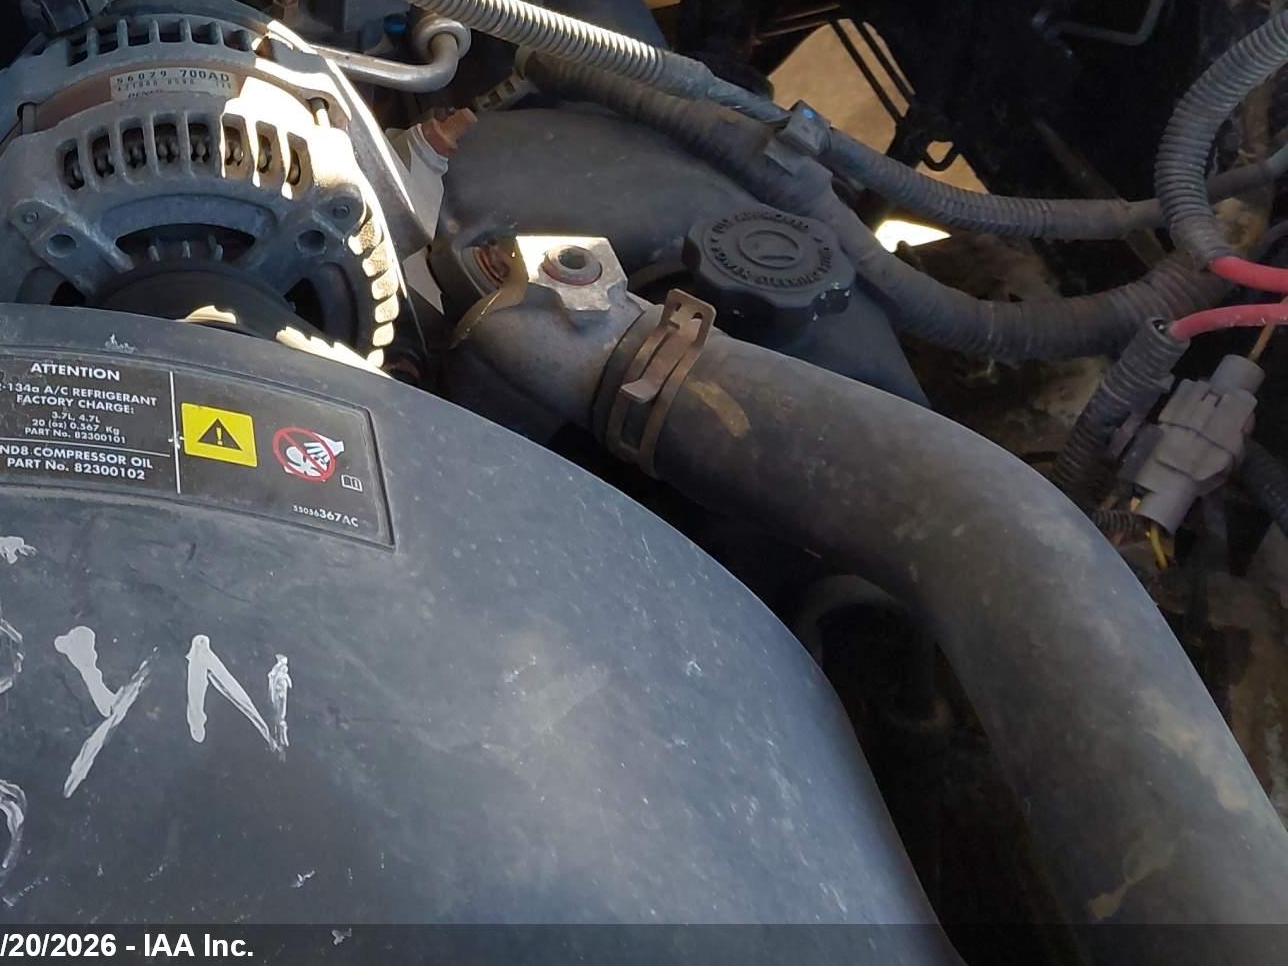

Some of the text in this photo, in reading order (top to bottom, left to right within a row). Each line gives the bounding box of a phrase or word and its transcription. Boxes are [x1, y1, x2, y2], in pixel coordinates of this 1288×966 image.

[30, 363, 121, 381] ATTENTION
[16, 394, 135, 414] FACTORY CHARGE:
[44, 385, 69, 395] A/C
[72, 387, 157, 406] REFRIGERANT
[32, 419, 46, 427] 20
[70, 422, 100, 432] 0.567
[106, 426, 120, 435] Kg
[79, 414, 101, 423] 4.7L
[25, 427, 126, 444] PART No. 82300101
[0, 445, 154, 469] ND8 COMPRESSOR OIL
[7, 458, 146, 480] PART No. 82300102
